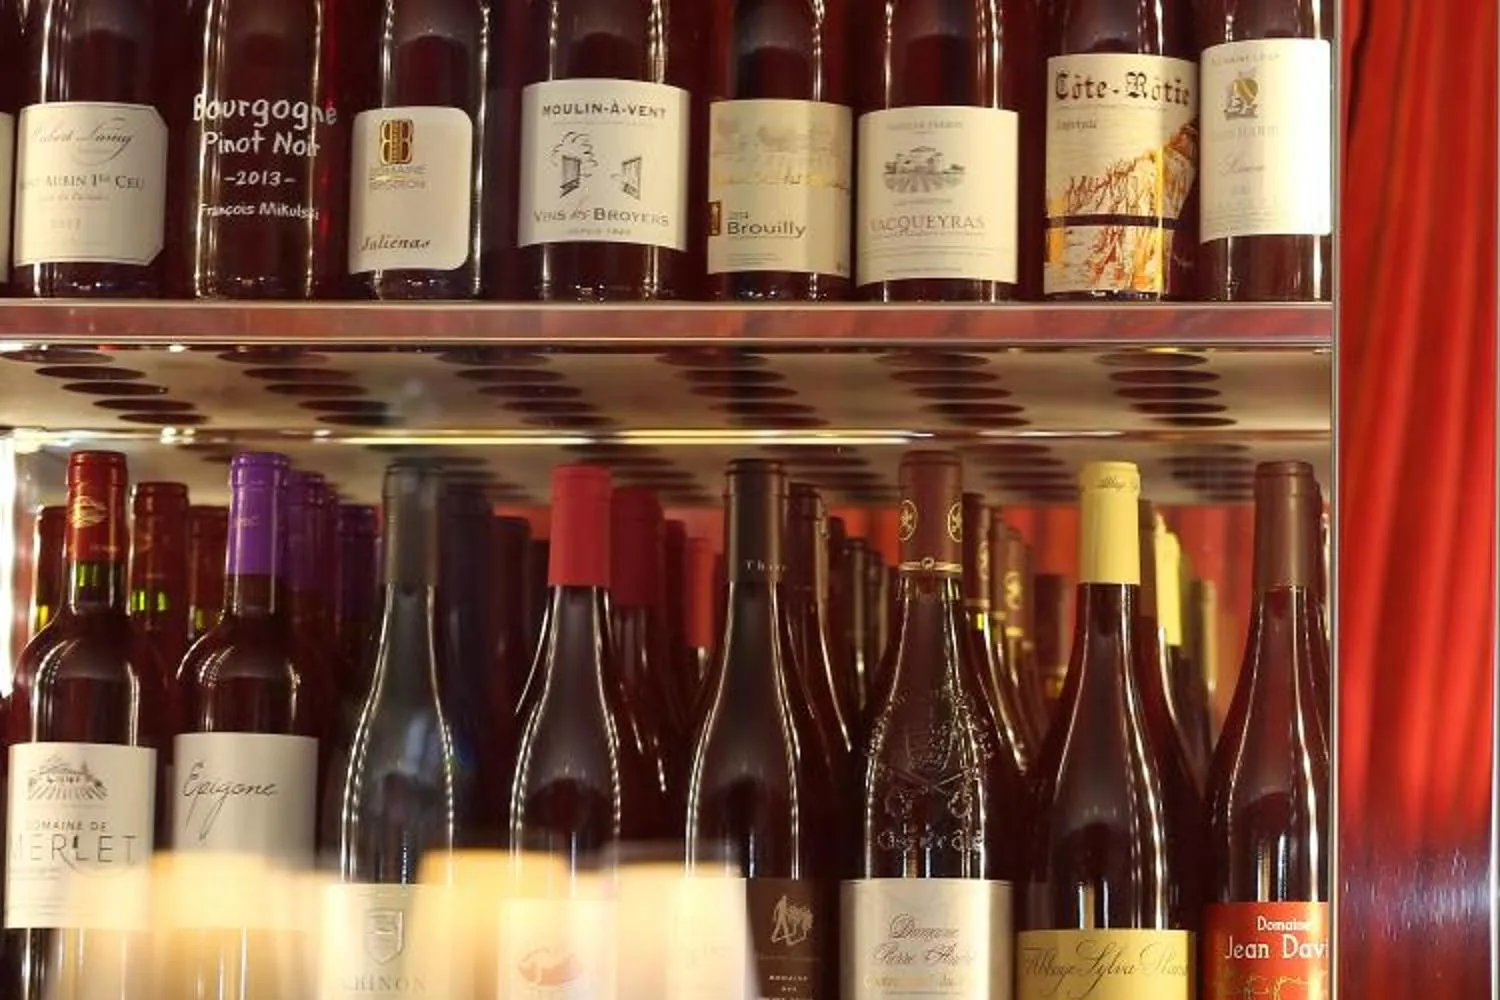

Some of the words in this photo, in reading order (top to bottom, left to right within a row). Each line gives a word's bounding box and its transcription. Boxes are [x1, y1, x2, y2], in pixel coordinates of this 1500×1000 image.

[192, 92, 337, 131] Bourgogne
[203, 129, 267, 154] Pinot
[272, 130, 321, 157] Noir
[199, 202, 257, 218] François
[726, 219, 808, 239] Brouilly
[30, 819, 84, 833] OMAINE
[90, 820, 109, 833] DE
[1223, 934, 1271, 960] Jean
